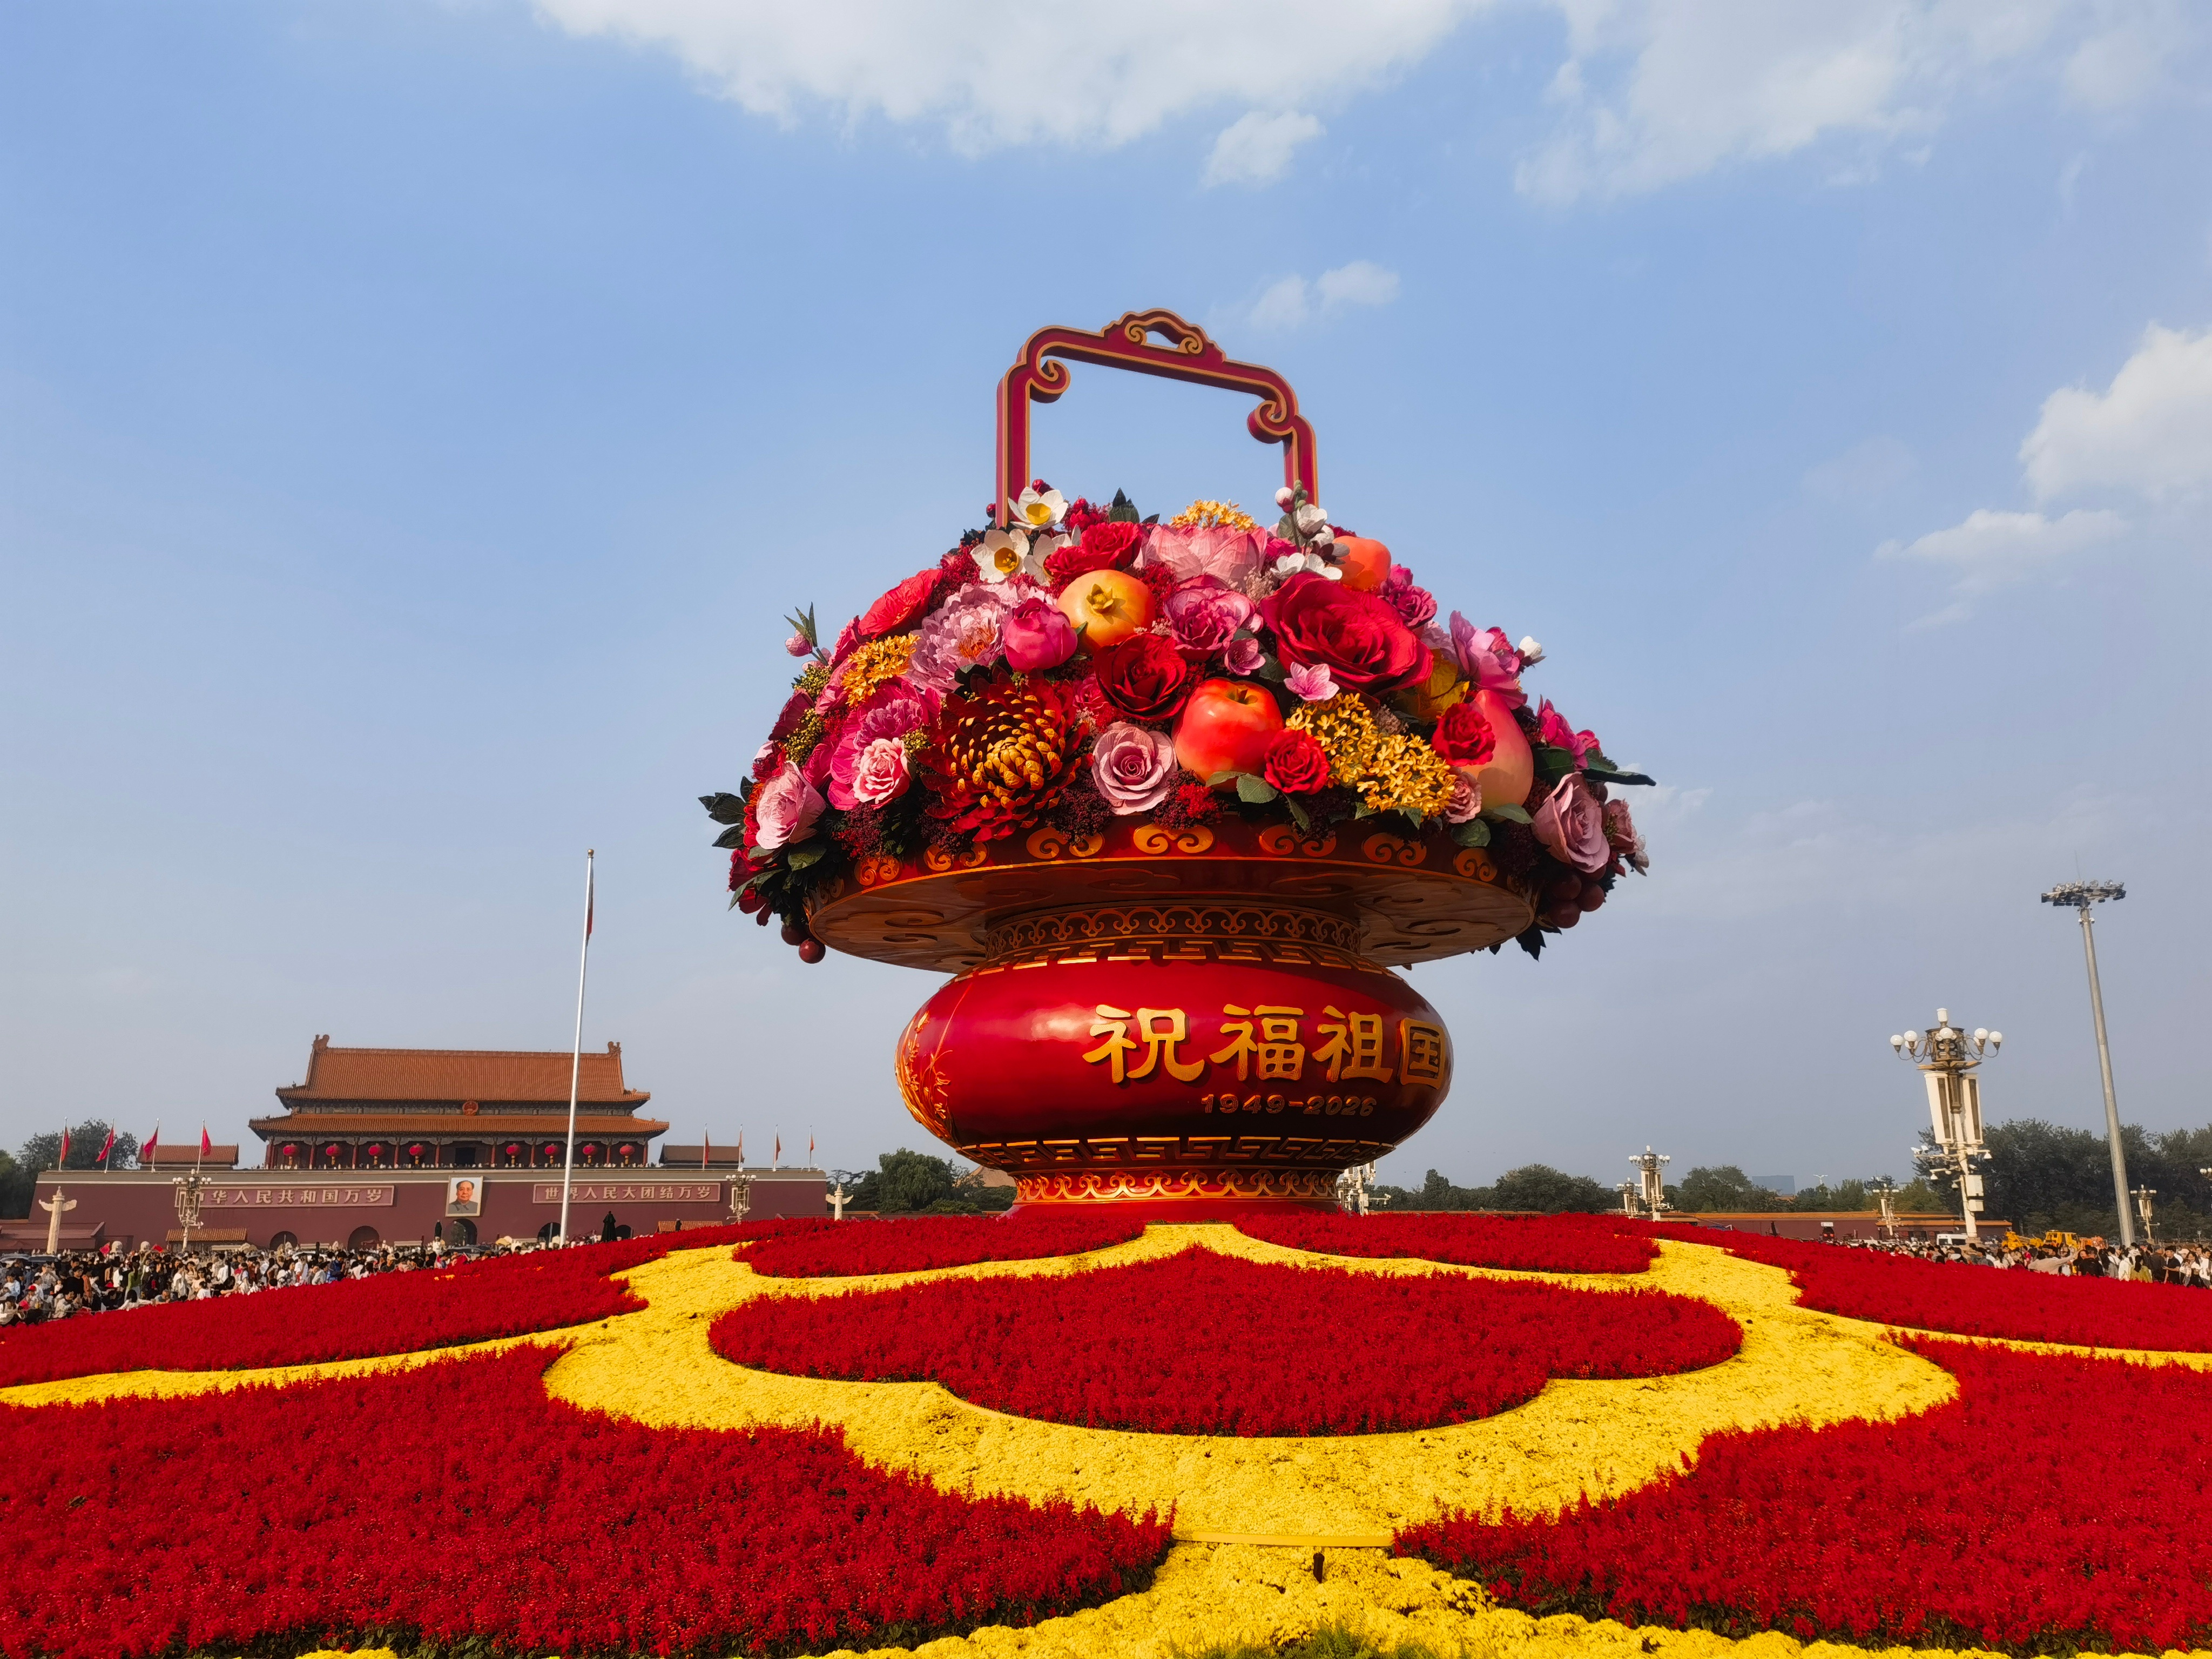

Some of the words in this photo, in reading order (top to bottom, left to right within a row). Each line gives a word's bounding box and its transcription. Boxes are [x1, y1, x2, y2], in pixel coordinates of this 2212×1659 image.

[1082, 1004, 1446, 1089] 祝福祖国
[1202, 1093, 1377, 1116] 1949-2026
